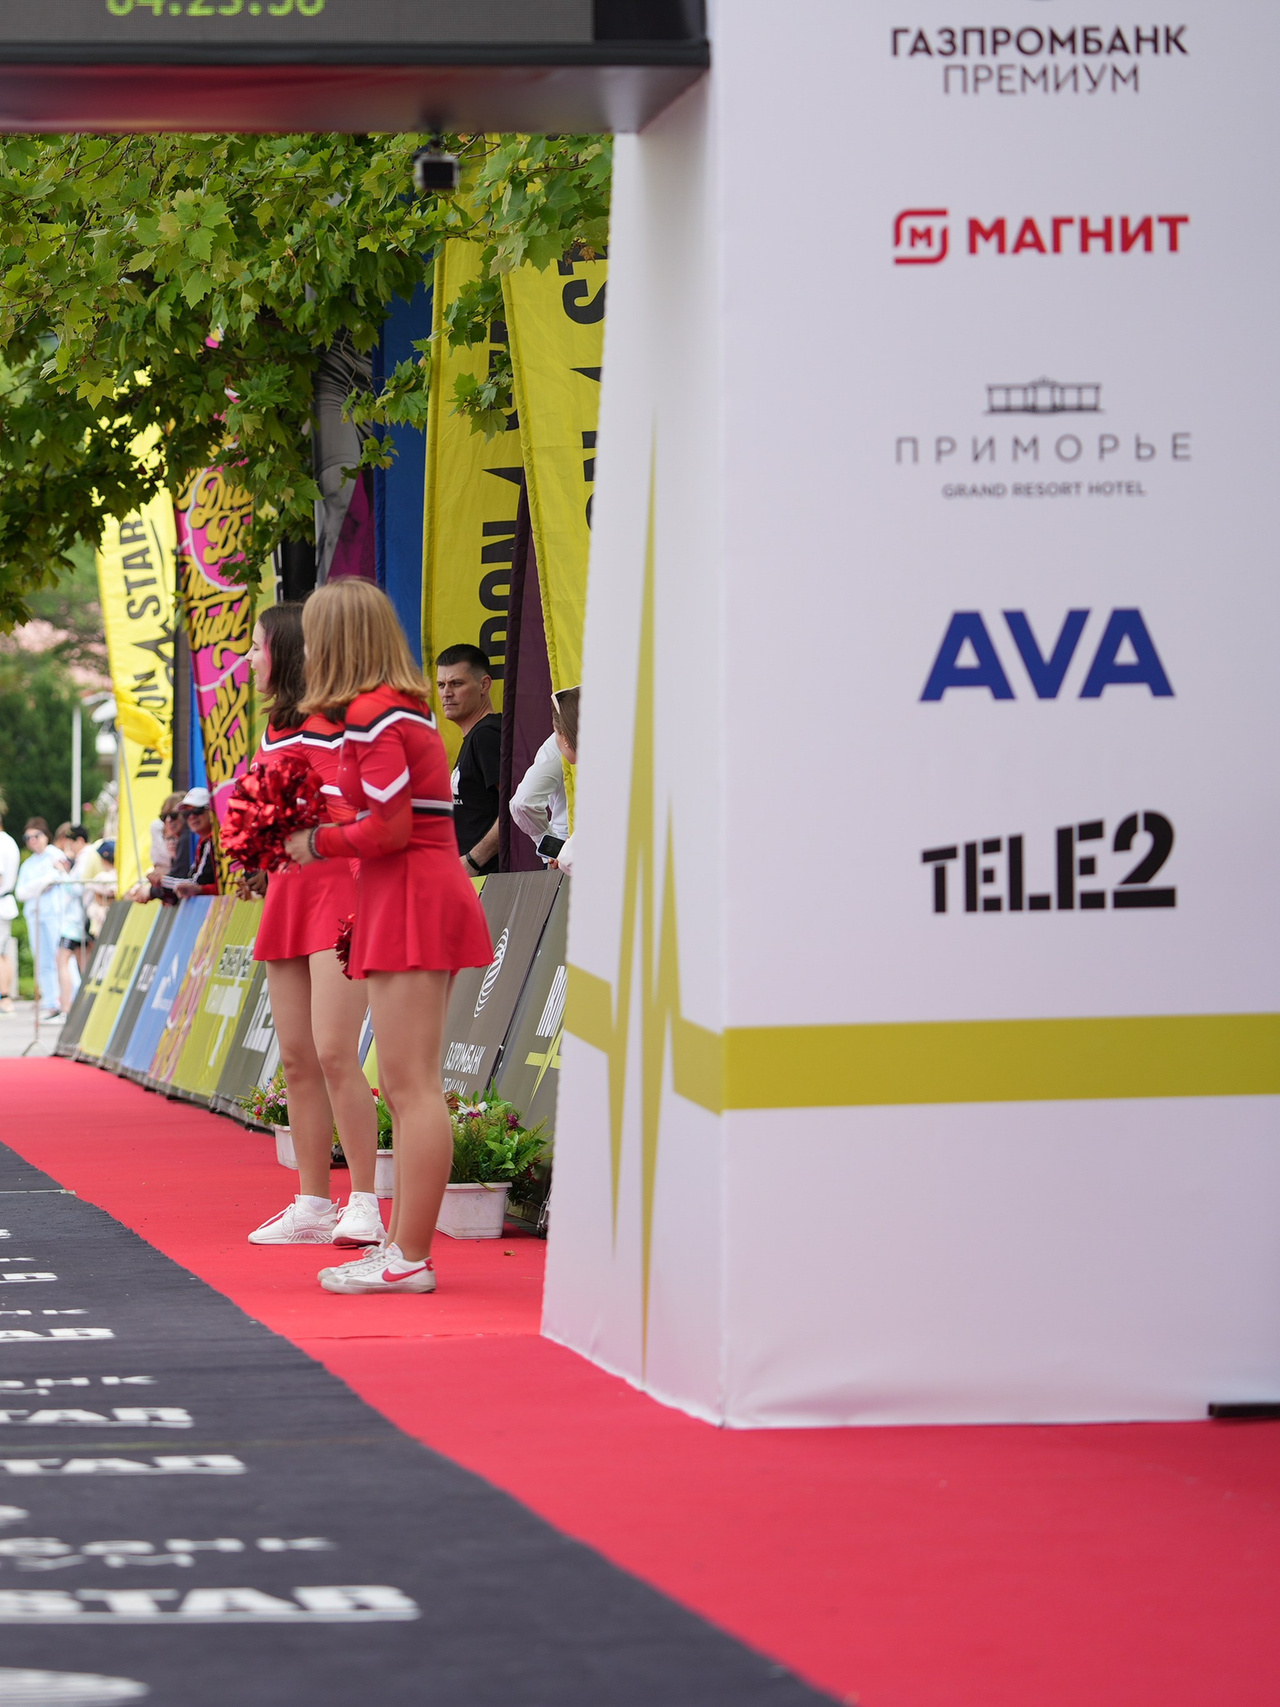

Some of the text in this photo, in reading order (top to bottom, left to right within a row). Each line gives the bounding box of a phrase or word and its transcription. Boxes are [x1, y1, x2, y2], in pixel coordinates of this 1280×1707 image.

[891, 25, 1189, 57] ГАЗПРОМБАНК
[943, 63, 1140, 96] ПРЕМИУМ
[967, 215, 1190, 255] МАГНИТ
[895, 432, 1192, 464] ПРИМОРЬЕ
[941, 480, 1146, 499] GRAND RESORT HOTEL
[120, 518, 161, 621] STAR
[918, 607, 1176, 702] AVA
[921, 809, 1177, 914] TELE2
